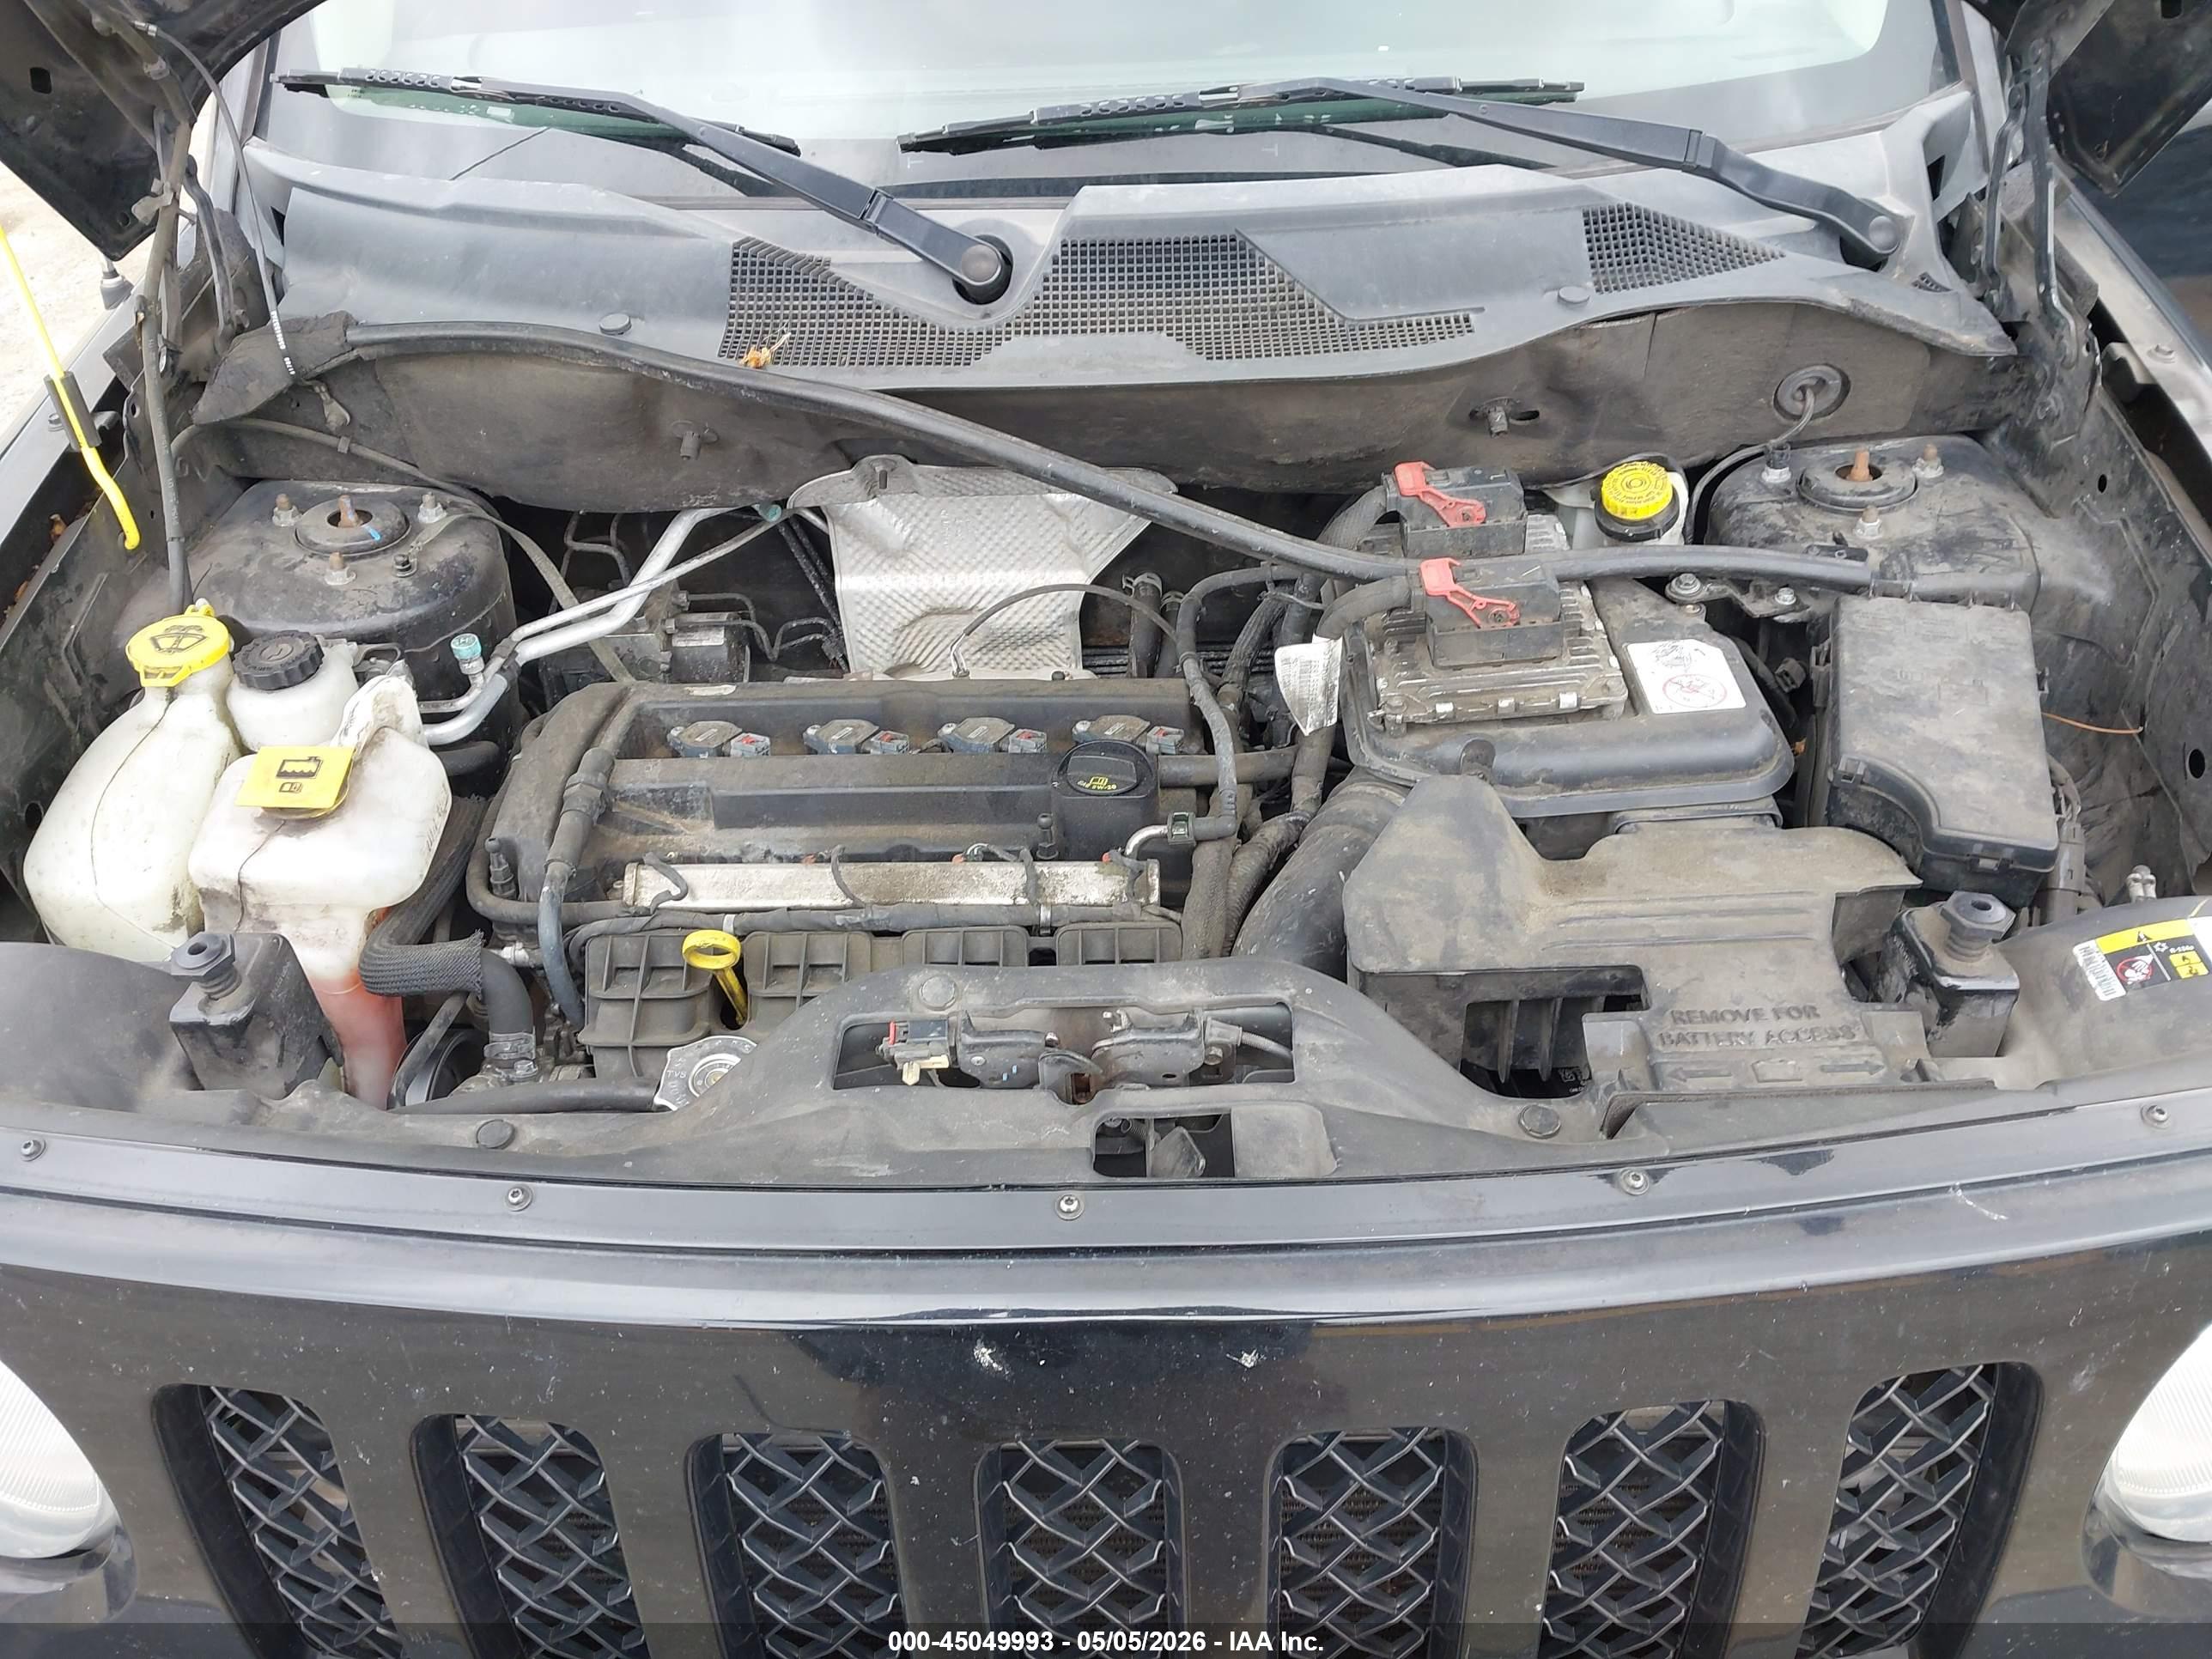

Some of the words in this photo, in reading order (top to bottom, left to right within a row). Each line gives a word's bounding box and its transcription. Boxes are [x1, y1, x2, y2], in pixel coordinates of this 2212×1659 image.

[1670, 1008, 1766, 1025] REMOVE
[1771, 1005, 1821, 1021] FOR
[1657, 1031, 1755, 1047] BATTERY
[1764, 1024, 1856, 1045] ACCESS
